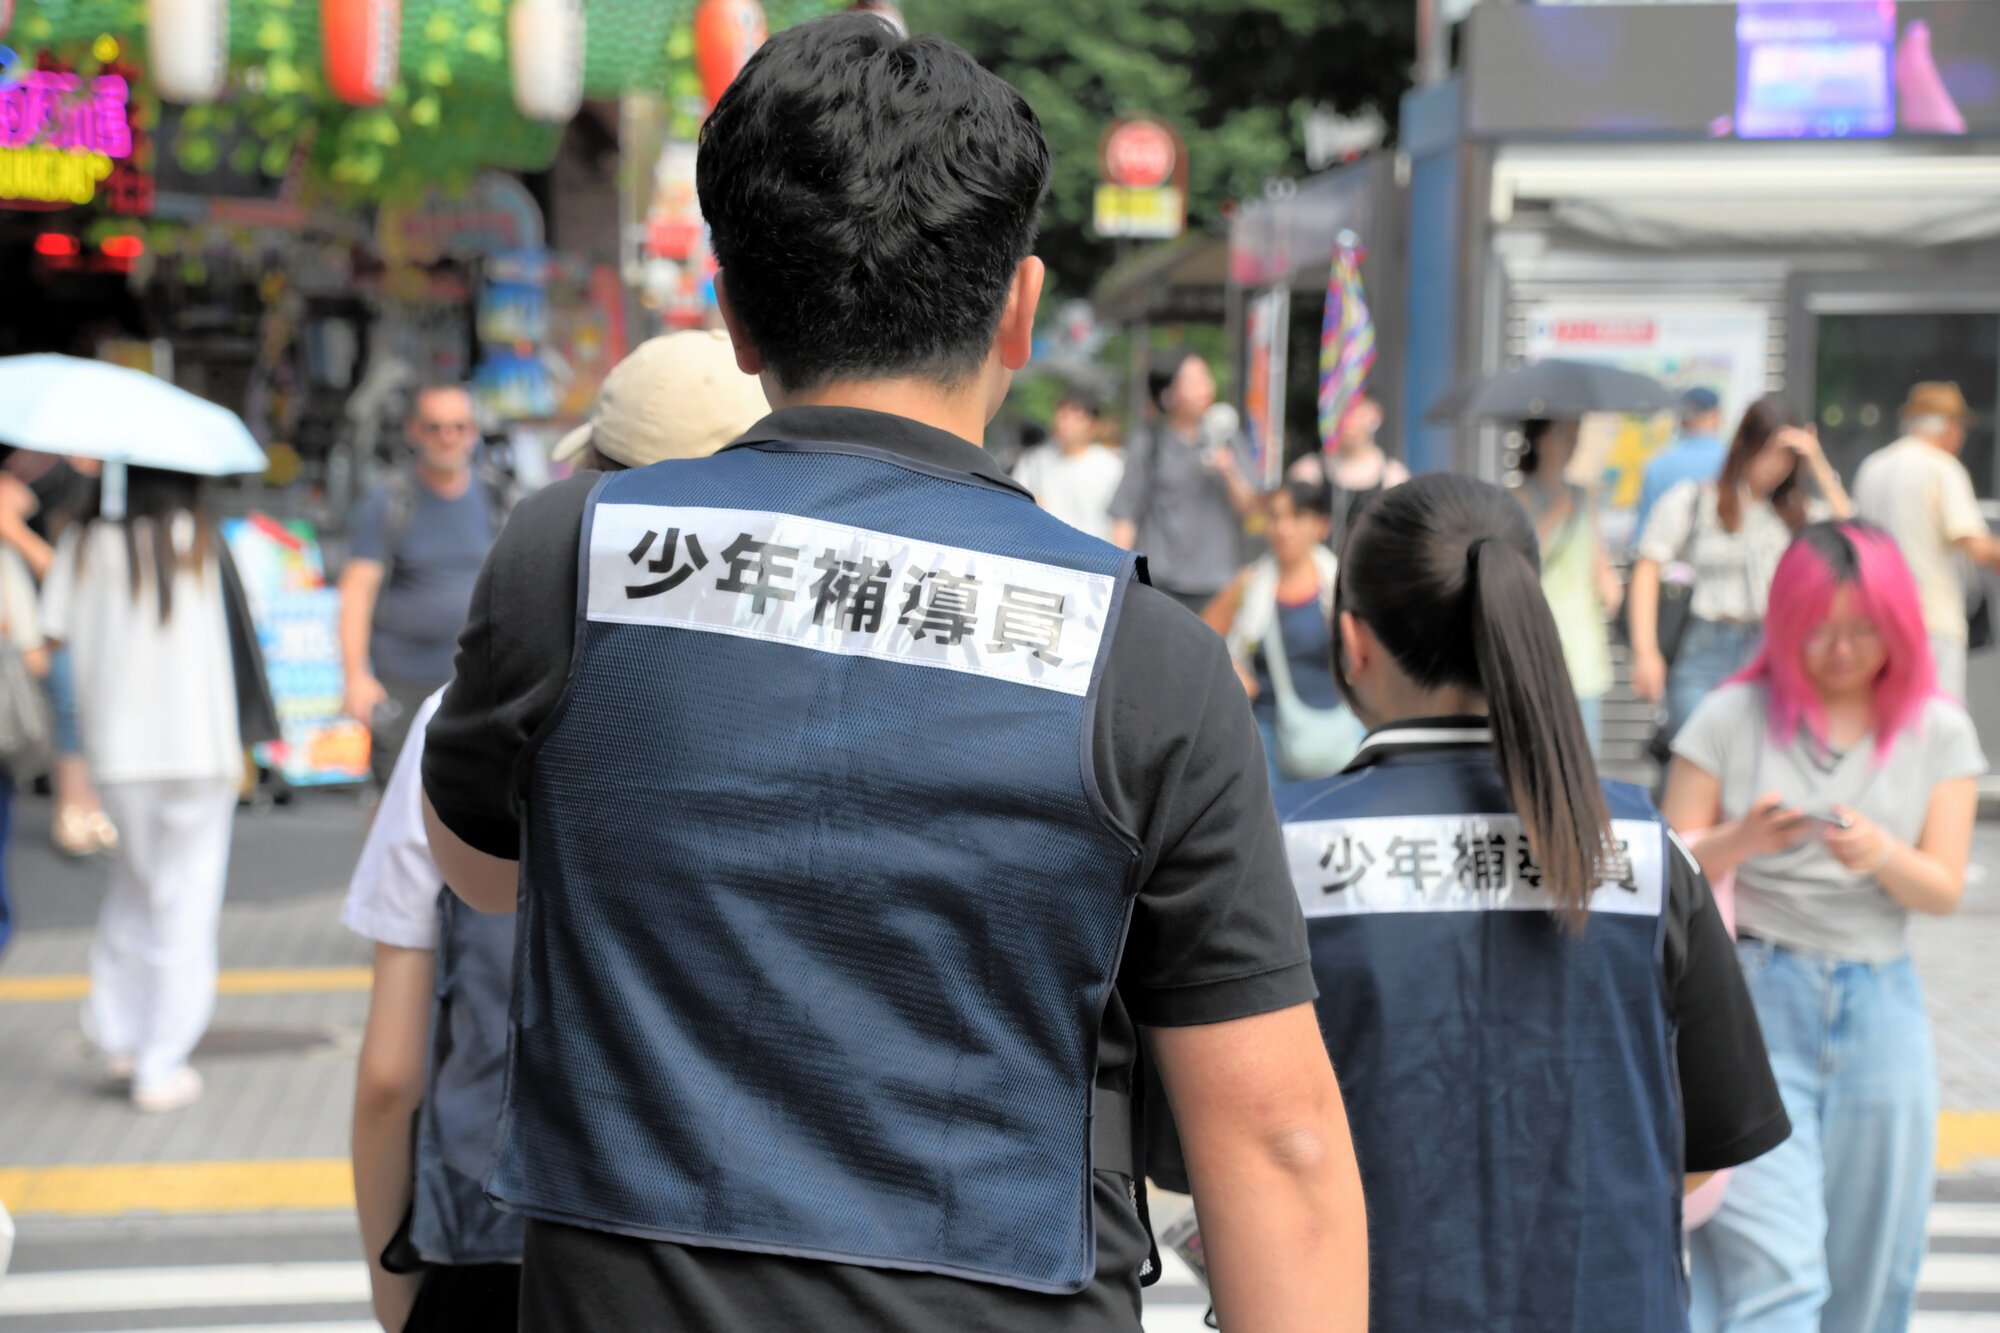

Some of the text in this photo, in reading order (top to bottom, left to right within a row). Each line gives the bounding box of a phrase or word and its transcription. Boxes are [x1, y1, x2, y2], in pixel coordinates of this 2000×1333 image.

[625, 527, 1066, 666] 少年補導員
